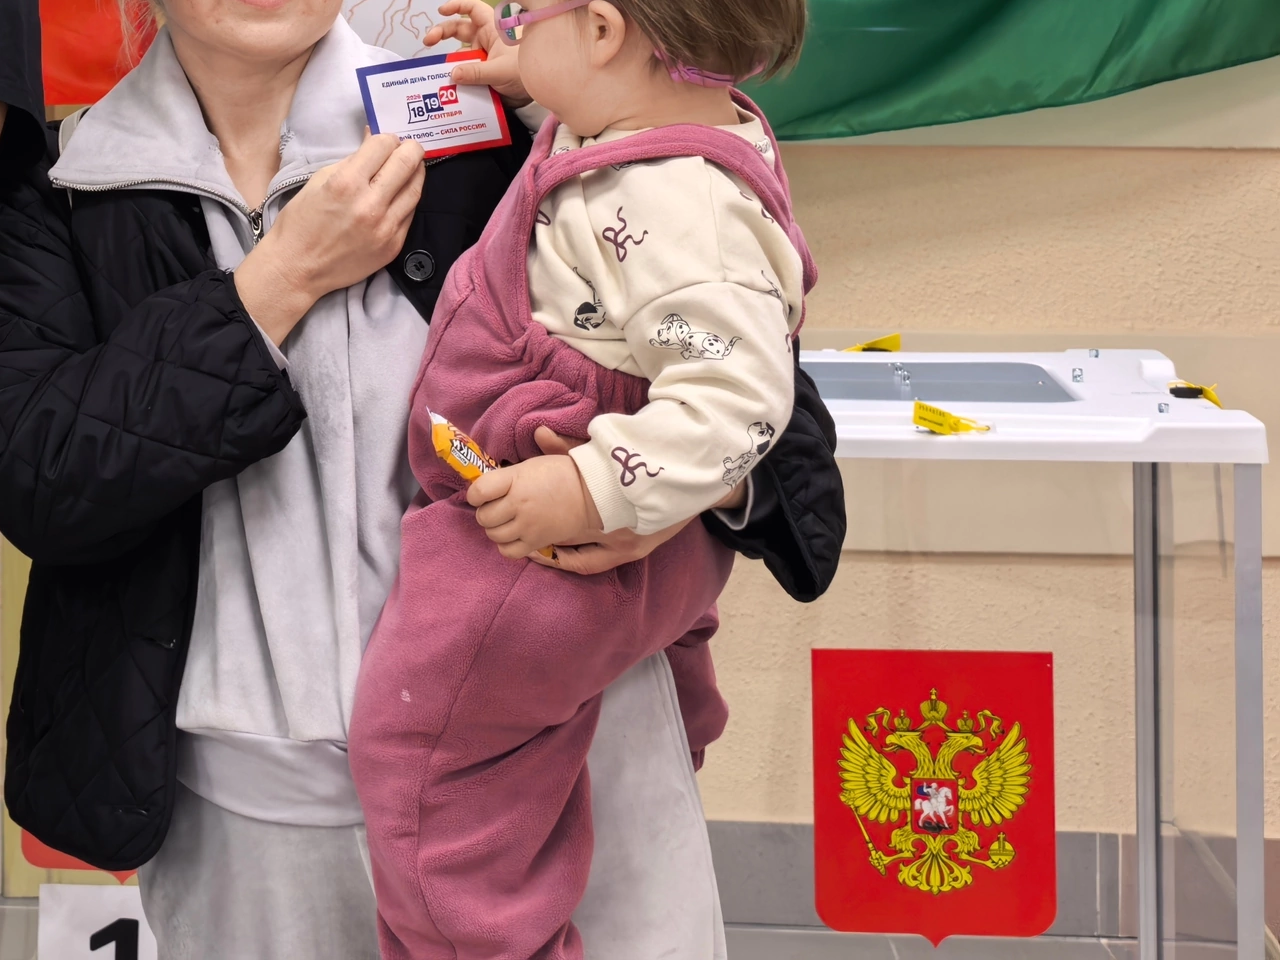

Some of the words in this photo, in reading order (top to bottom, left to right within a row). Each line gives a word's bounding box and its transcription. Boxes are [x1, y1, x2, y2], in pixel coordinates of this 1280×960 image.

[382, 77, 409, 88] ЕДИНЫЙ
[409, 76, 427, 85] ДЕНЬ
[410, 106, 425, 118] 18
[424, 97, 439, 110] 19
[439, 89, 456, 102] 20
[430, 110, 463, 121] СЕНТЯБРЯ
[399, 133, 412, 141] ВОЙ
[412, 131, 434, 140] ГОЛОС
[440, 127, 458, 136] СИЛА
[459, 123, 487, 132] РОССИИ!
[89, 917, 140, 960] 1
